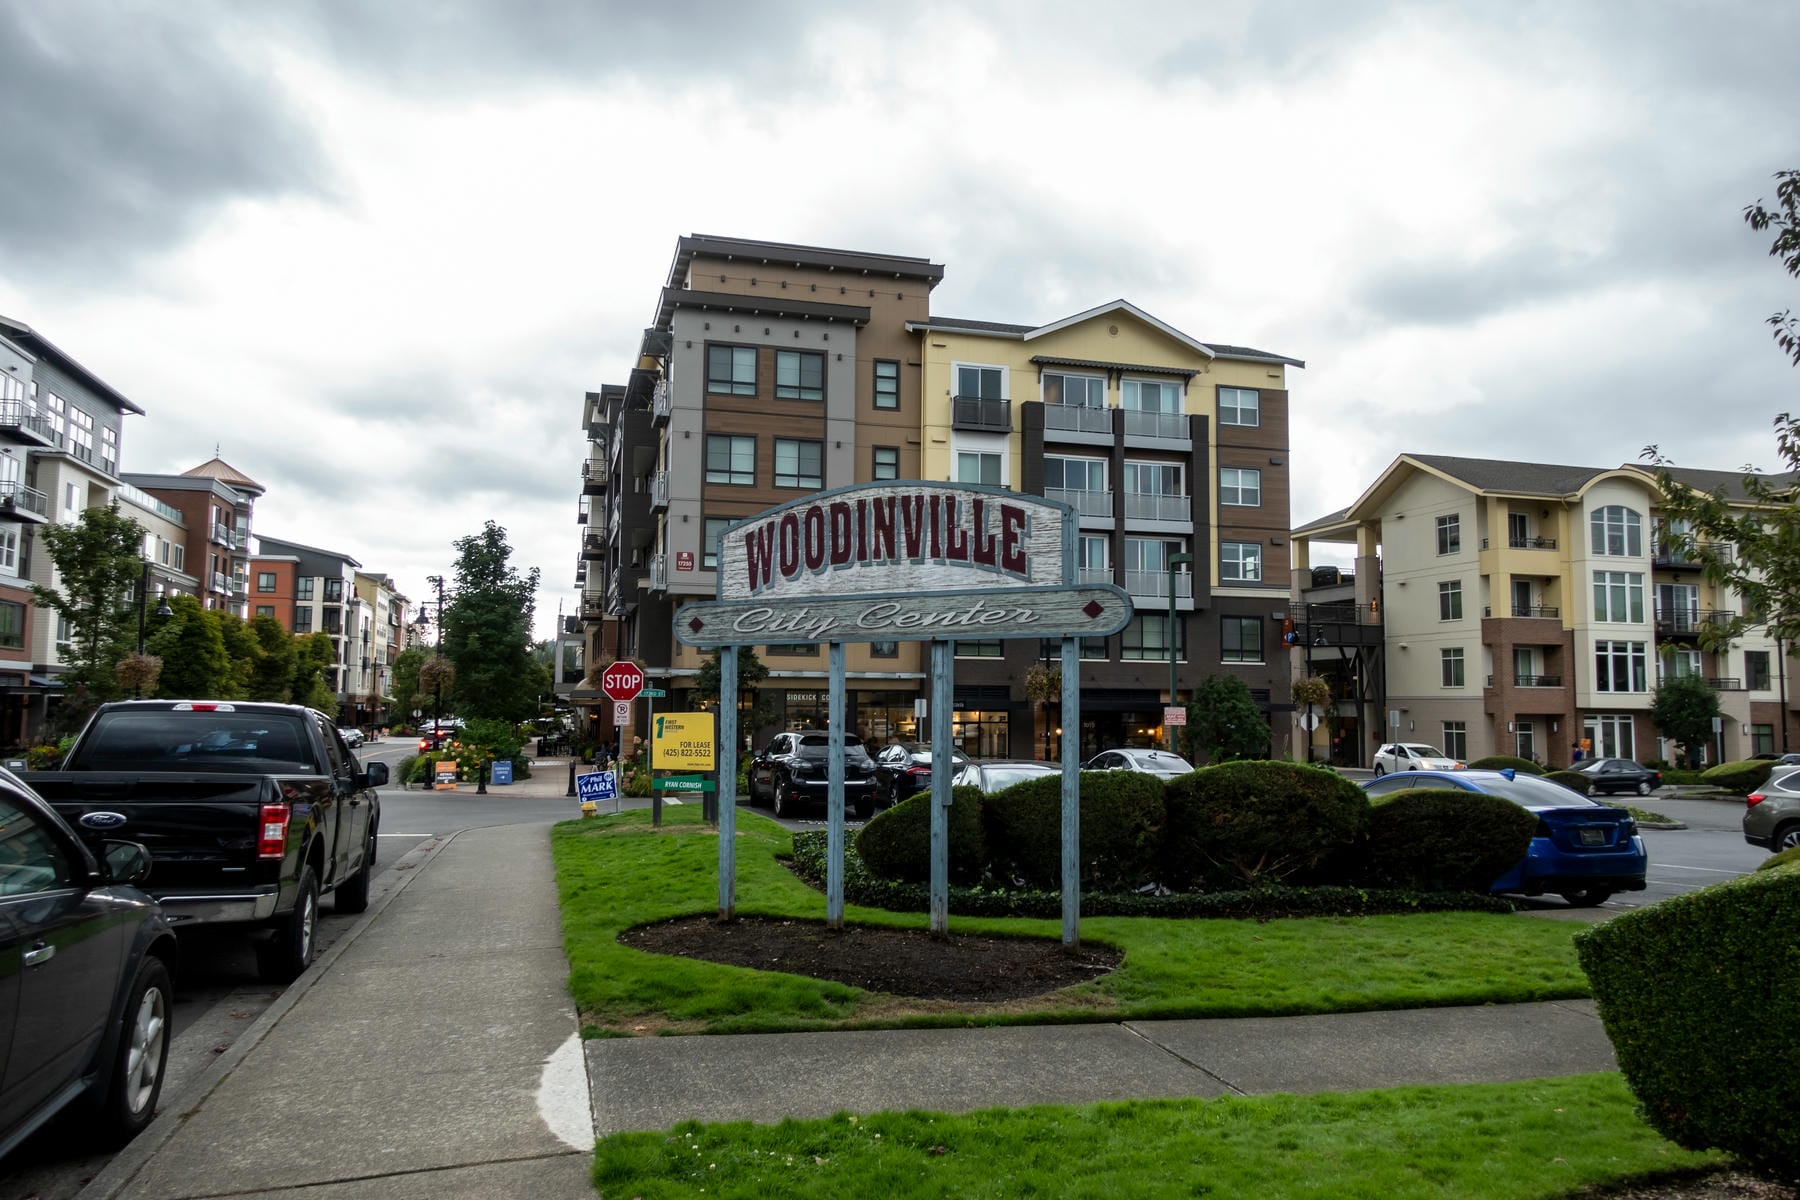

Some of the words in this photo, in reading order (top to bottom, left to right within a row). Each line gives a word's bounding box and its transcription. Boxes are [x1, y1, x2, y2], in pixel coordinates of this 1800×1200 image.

[745, 494, 1030, 594] WOODINVILLE
[732, 606, 839, 639] City
[856, 600, 1039, 629] Center
[605, 674, 641, 689] STOP
[786, 693, 817, 701] SIDEKICK
[680, 741, 692, 749] FOR
[693, 741, 711, 749] LEASE
[663, 748, 680, 758] (425)
[680, 749, 711, 757] 822-5522
[589, 775, 603, 783] Phil
[580, 780, 614, 794] MARK
[679, 781, 703, 789] CORNISH
